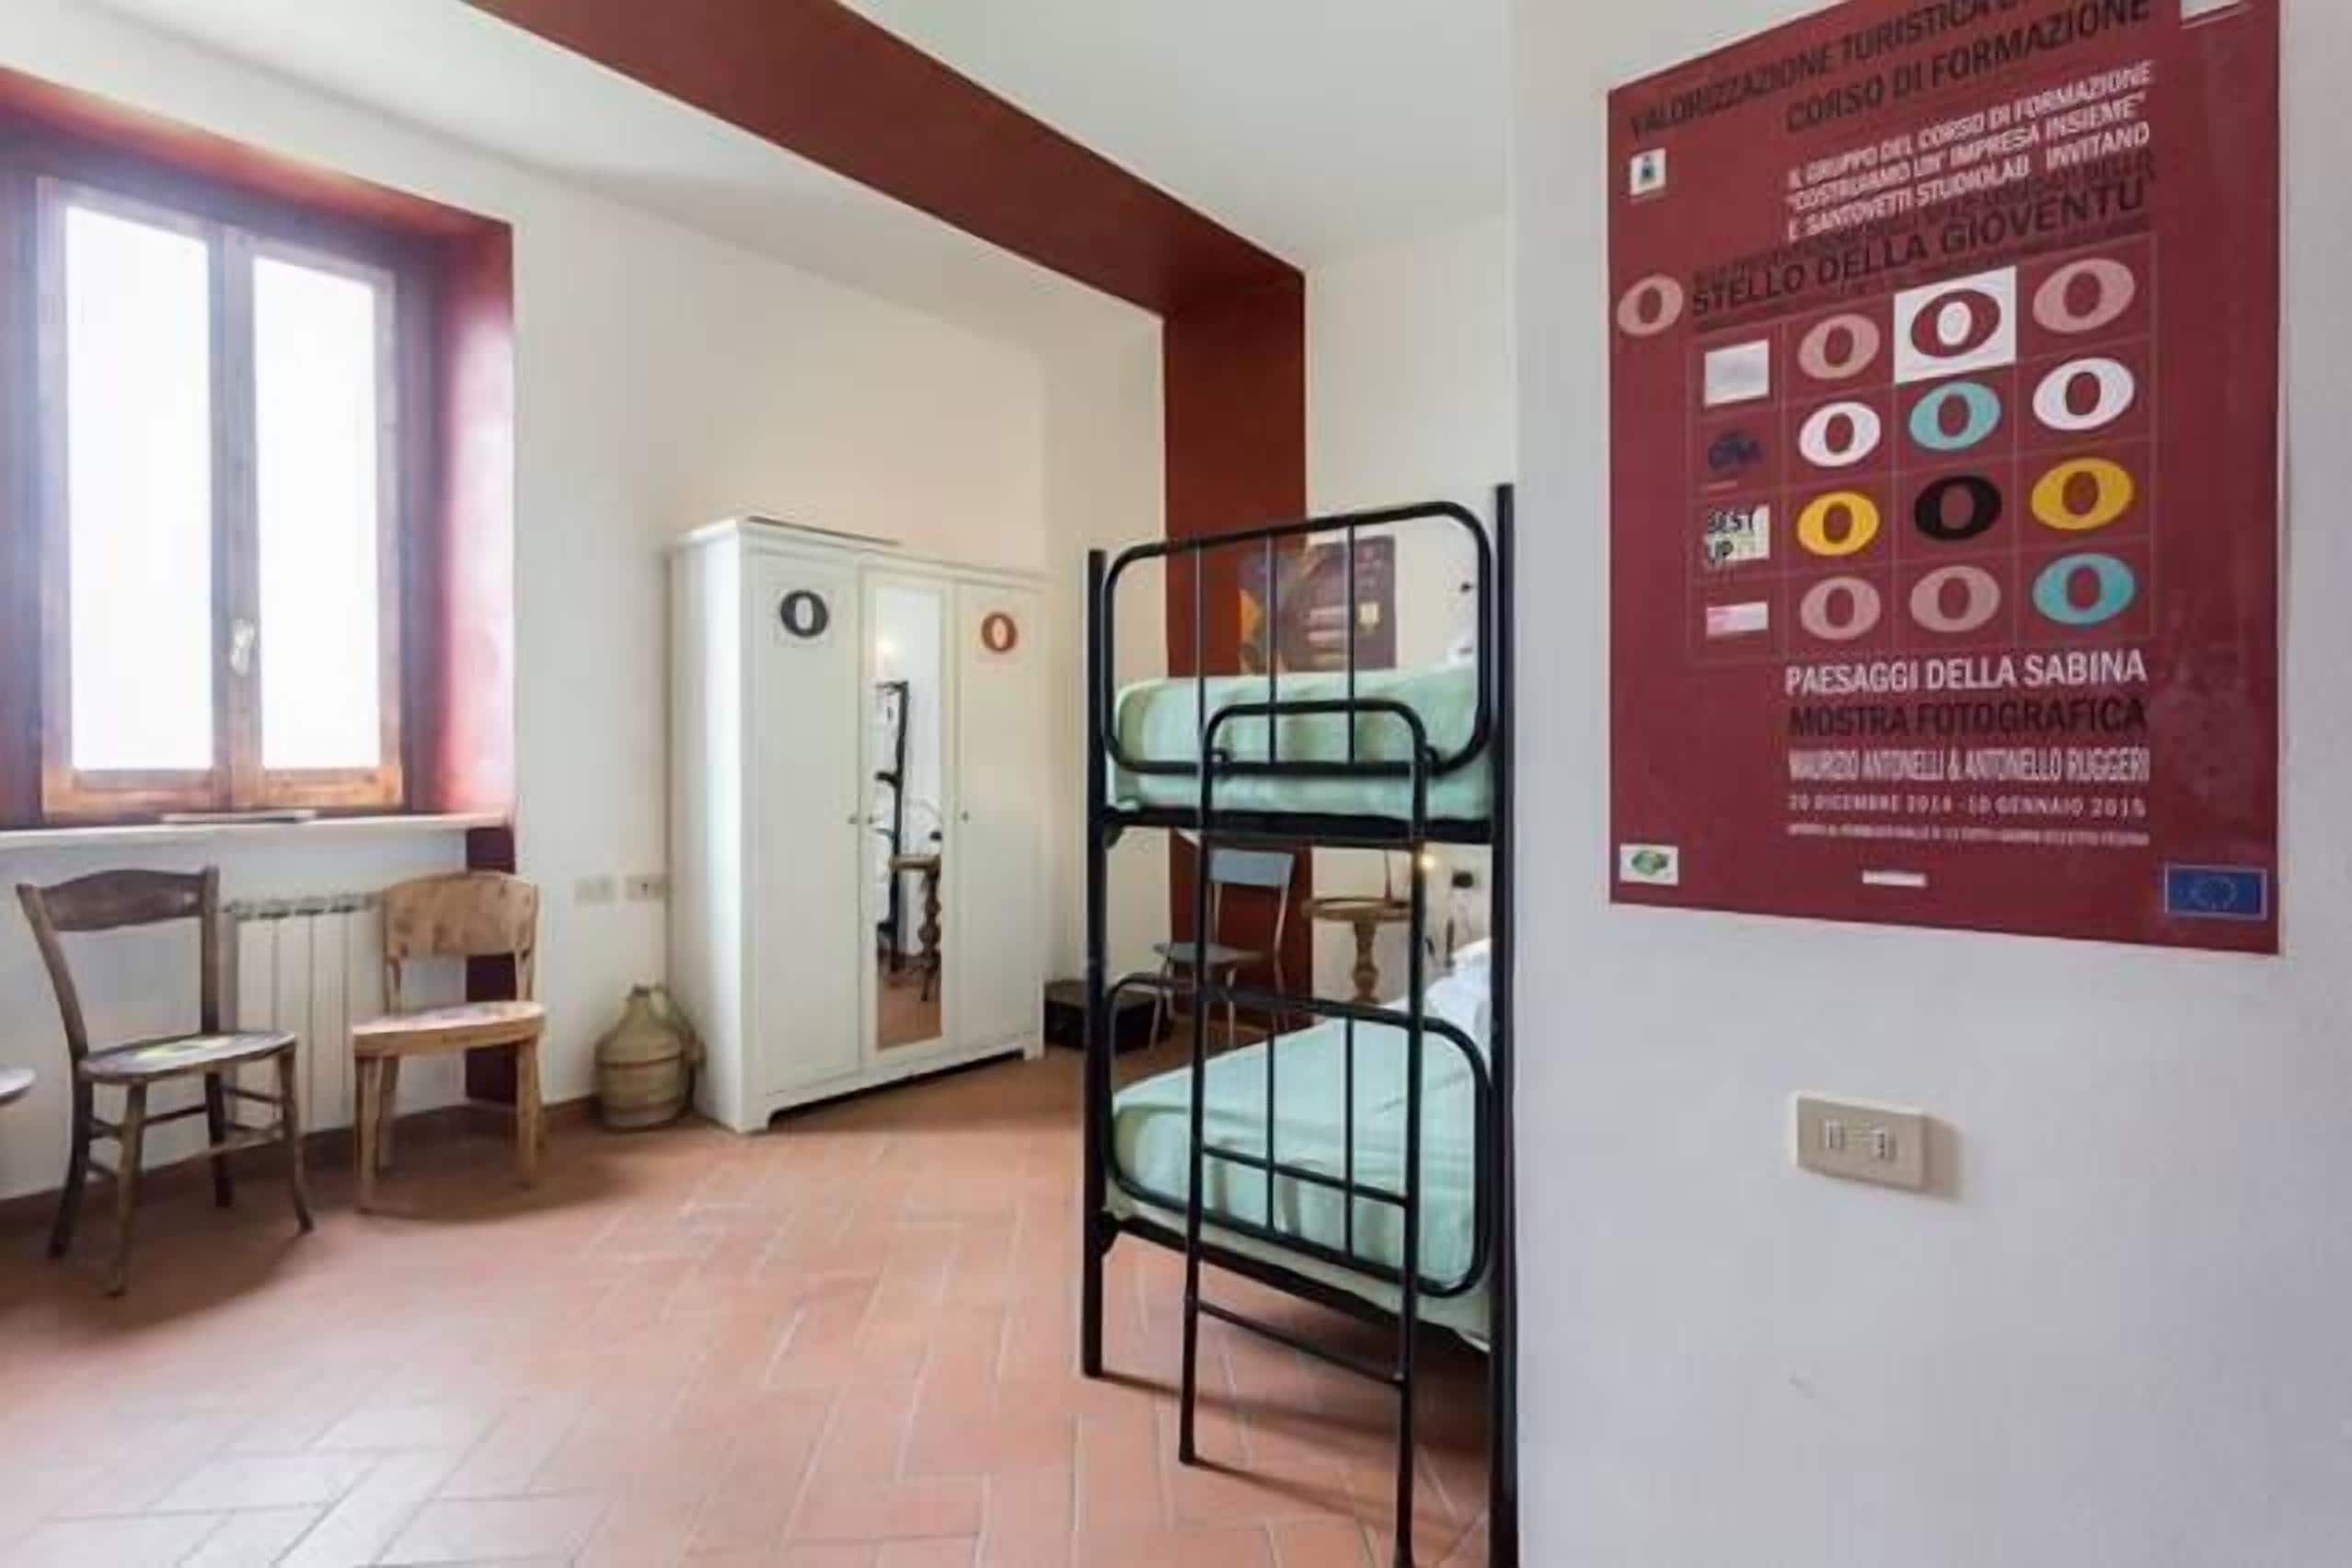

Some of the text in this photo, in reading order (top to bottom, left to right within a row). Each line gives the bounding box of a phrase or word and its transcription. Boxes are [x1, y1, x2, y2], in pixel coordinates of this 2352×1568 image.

[1785, 0, 2150, 133] CORSO DI FORMAZIONE
[1816, 233, 1929, 285] DELLA
[1785, 649, 2149, 696] PAESAGGI DELLA SABINA
[1788, 695, 2149, 737] MOSTRA FOTOGRAFICA
